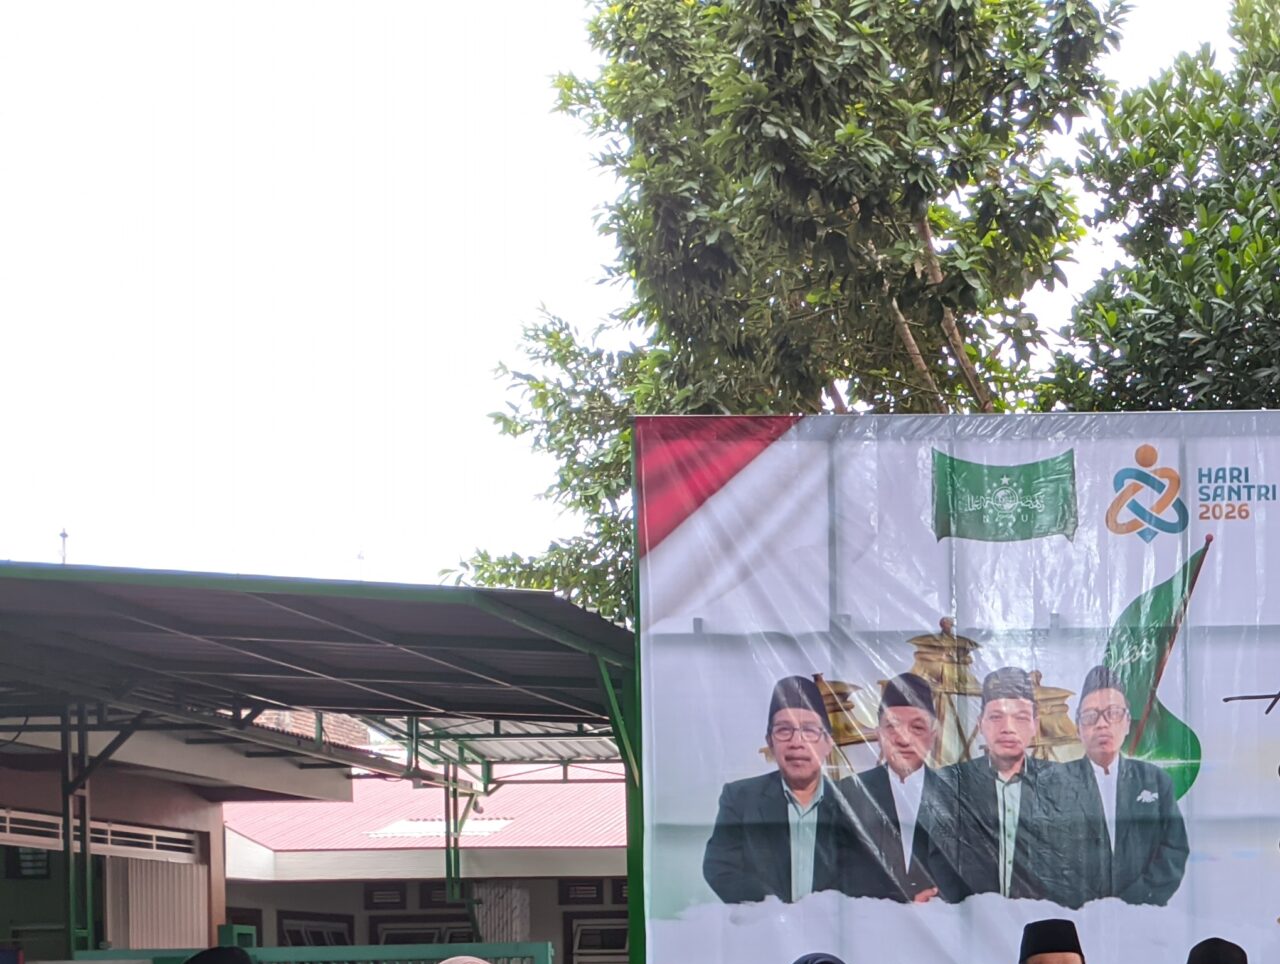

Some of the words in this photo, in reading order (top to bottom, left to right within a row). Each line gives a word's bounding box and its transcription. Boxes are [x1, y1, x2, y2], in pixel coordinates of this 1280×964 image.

[1198, 467, 1249, 483] HARI
[1198, 484, 1277, 501] SANTRI
[1199, 503, 1250, 520] 2026
